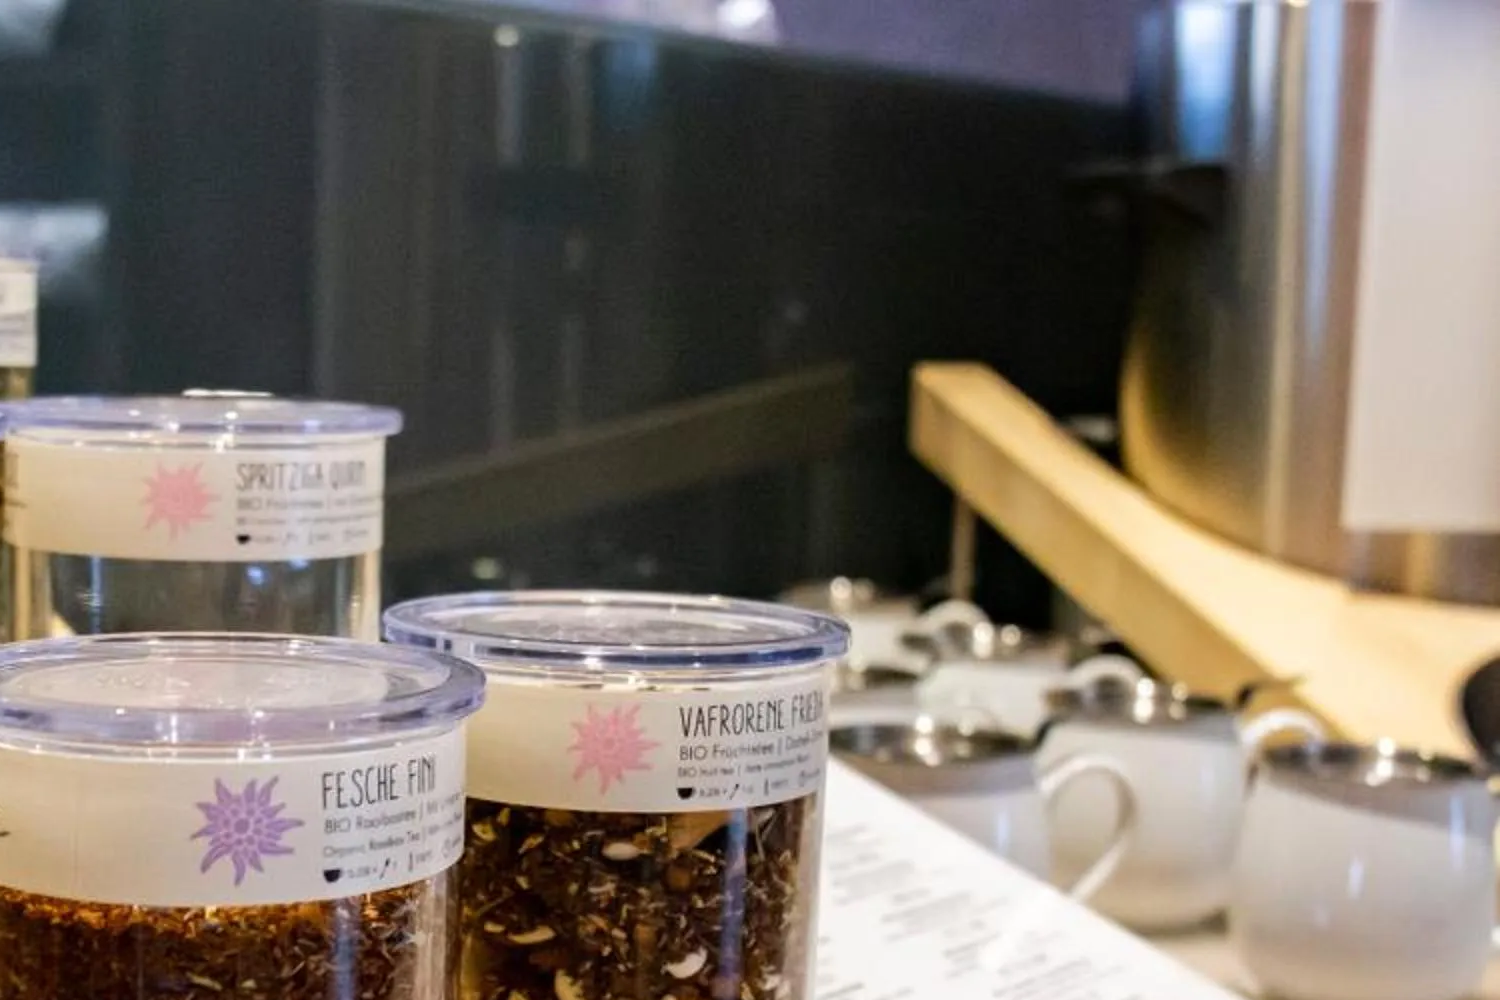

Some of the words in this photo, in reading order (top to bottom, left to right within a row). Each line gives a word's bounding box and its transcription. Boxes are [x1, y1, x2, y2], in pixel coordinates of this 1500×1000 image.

[678, 699, 785, 738] VAFRORENE
[679, 745, 708, 761] BIO
[322, 762, 400, 810] FESCHE
[407, 752, 436, 796] FINI
